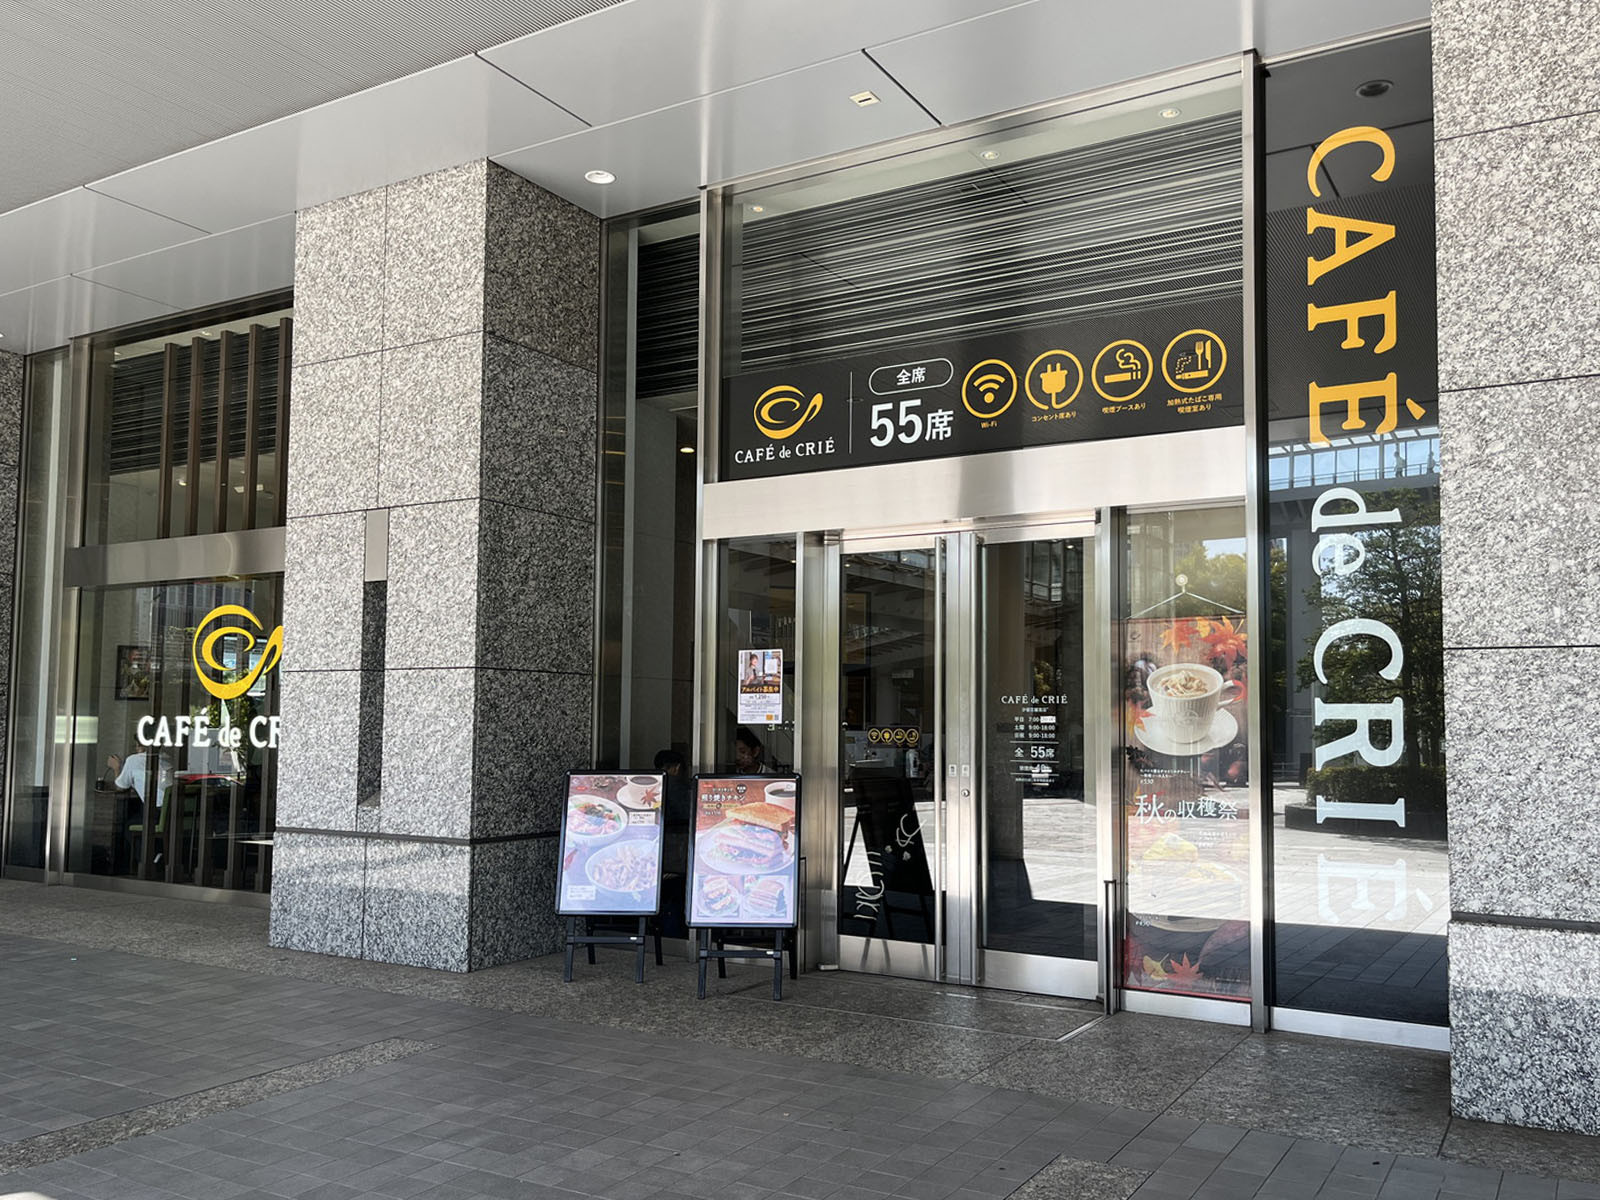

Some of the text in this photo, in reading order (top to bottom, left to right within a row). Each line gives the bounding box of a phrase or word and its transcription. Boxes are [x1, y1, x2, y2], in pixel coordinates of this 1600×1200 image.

[896, 366, 926, 386] 全席
[1167, 393, 1222, 407] 加熱式たばこ専用
[1102, 402, 1146, 414] 喫煙ブースあり
[1177, 403, 1211, 414] 喫煙室あり
[869, 398, 954, 447] 55席
[1031, 411, 1077, 422] コンセント席あり
[981, 420, 998, 429] Wi-Fi
[734, 436, 835, 464] CAFÉ de CRIÉ
[1307, 125, 1433, 924] CAFÉ de CRIÉ
[1001, 694, 1068, 704] CAFÉ de CRIÉ
[137, 707, 211, 748] CAFÉ
[218, 715, 242, 748] de
[1014, 746, 1055, 758] 全 55席
[1134, 794, 1239, 825] 秋の収穫祭
